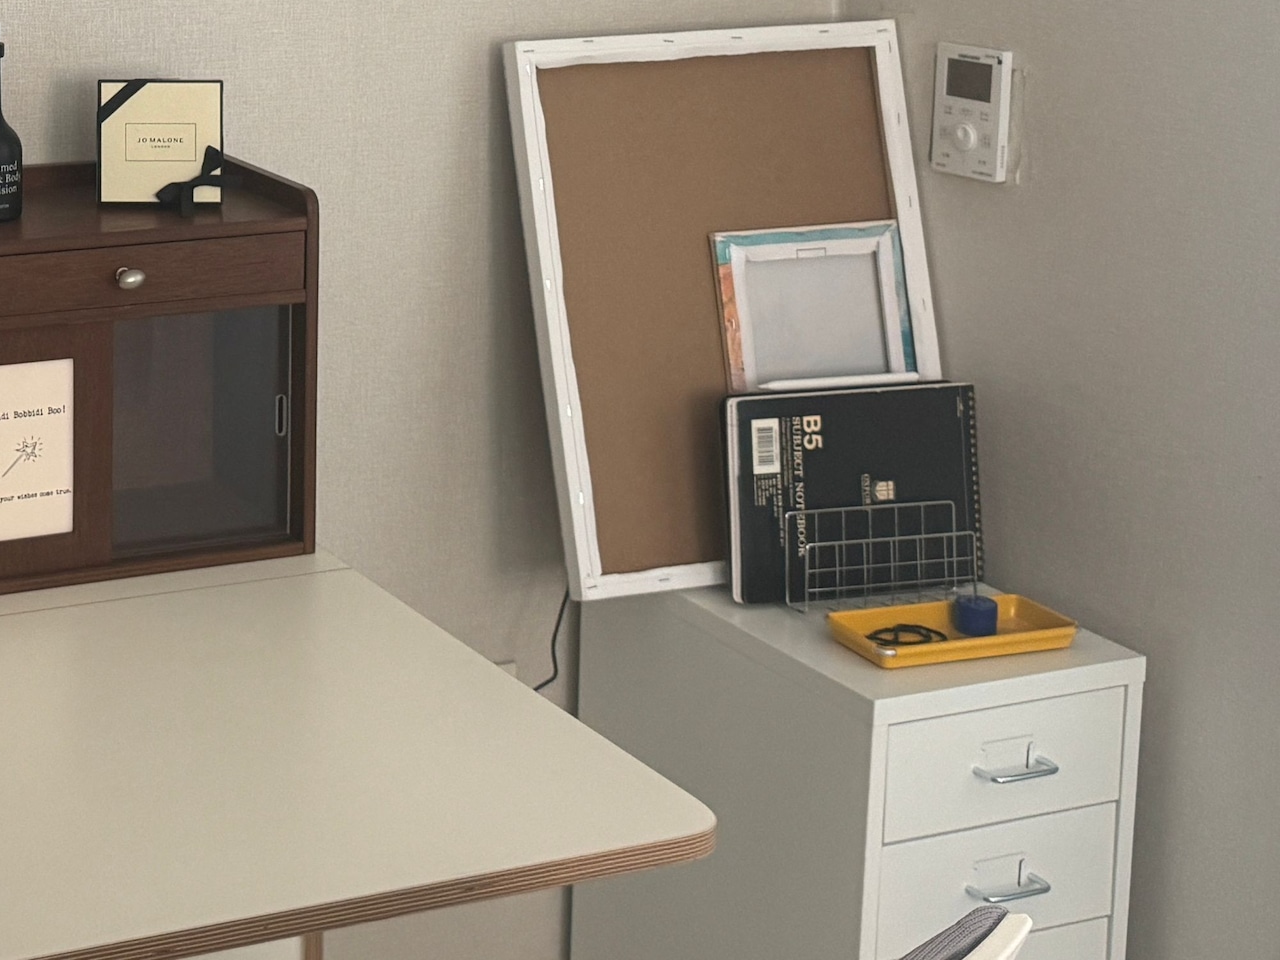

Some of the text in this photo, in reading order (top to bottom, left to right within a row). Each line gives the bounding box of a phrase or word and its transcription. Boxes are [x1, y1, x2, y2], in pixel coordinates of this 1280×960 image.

[13, 408, 43, 419] Bobbidi
[47, 405, 66, 415] Boo!
[792, 416, 804, 478] SUBJECT
[802, 414, 823, 451] B5
[0, 495, 15, 504] your
[17, 492, 38, 500] wishes
[862, 473, 871, 506] OXFOR
